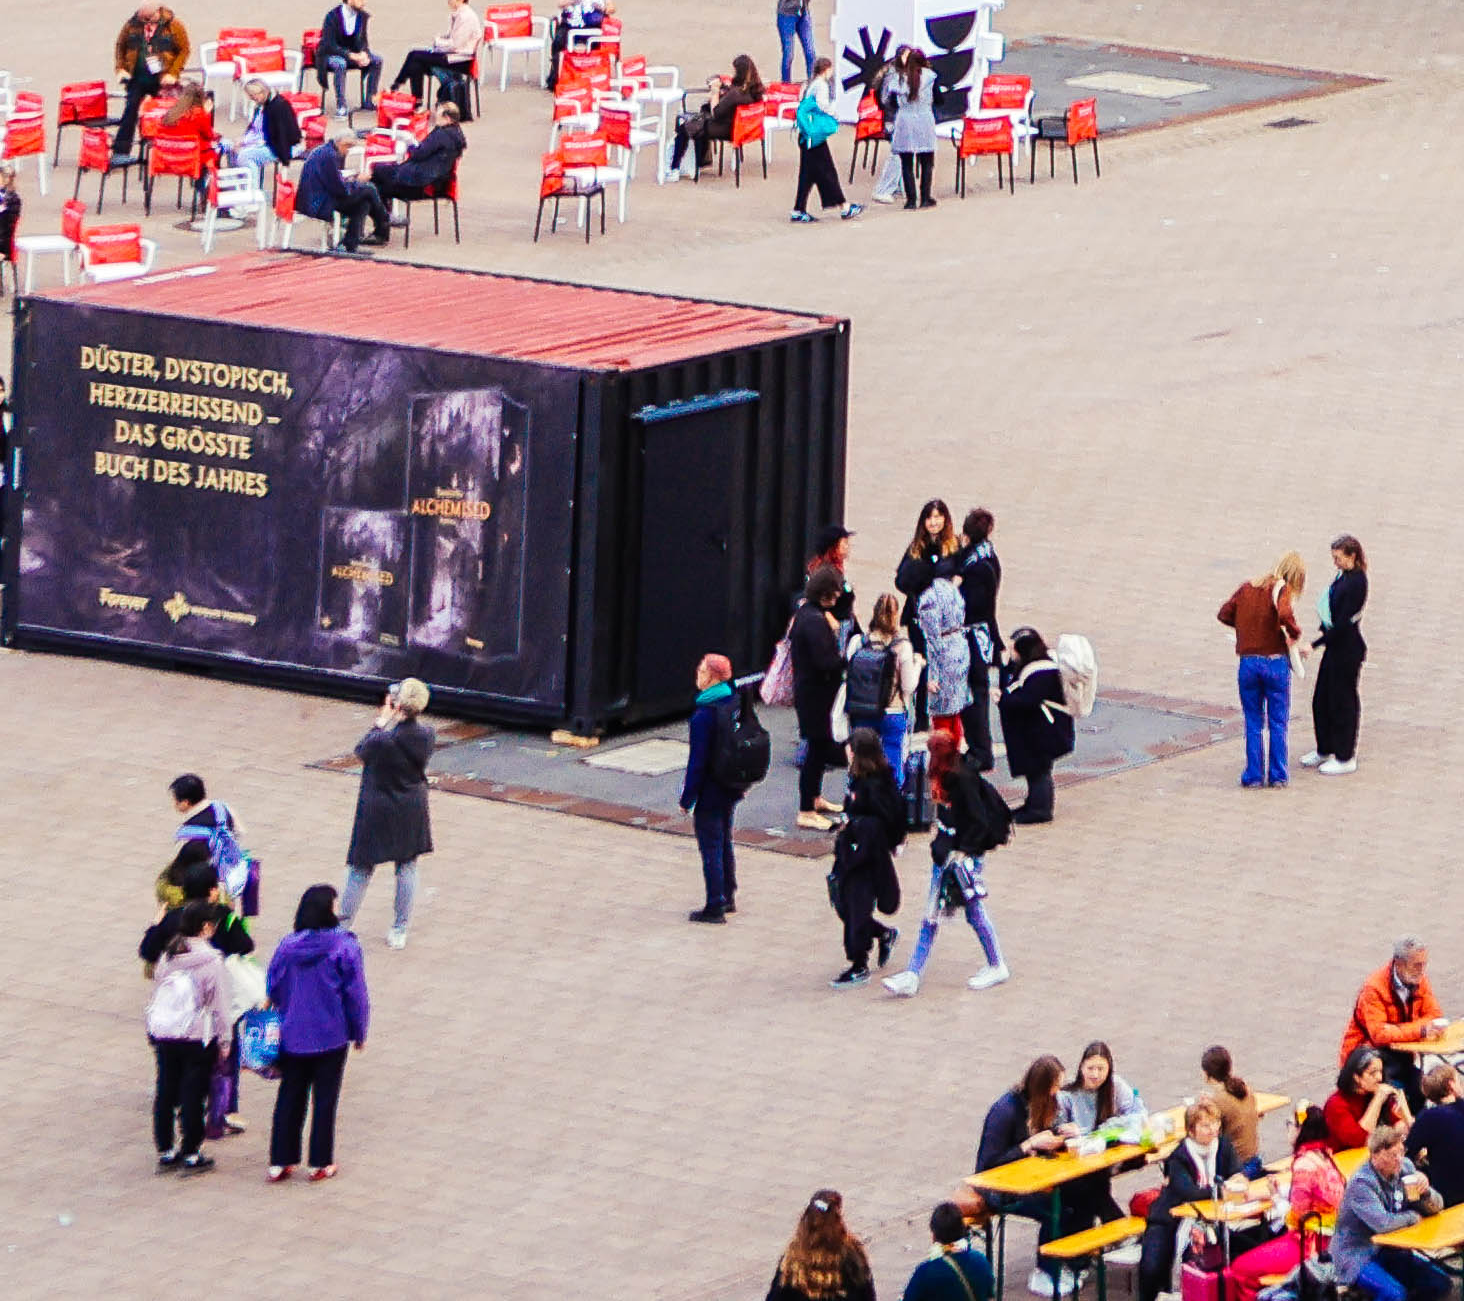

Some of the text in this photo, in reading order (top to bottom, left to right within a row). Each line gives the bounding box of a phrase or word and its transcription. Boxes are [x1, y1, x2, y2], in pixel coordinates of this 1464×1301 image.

[80, 343, 295, 400] DÜSTER, DYSTOPISCH,
[89, 381, 264, 427] HERZZERREISSEND
[115, 418, 253, 461] DAS GRÖSSTE
[95, 450, 270, 499] BUCH DES JAHRES
